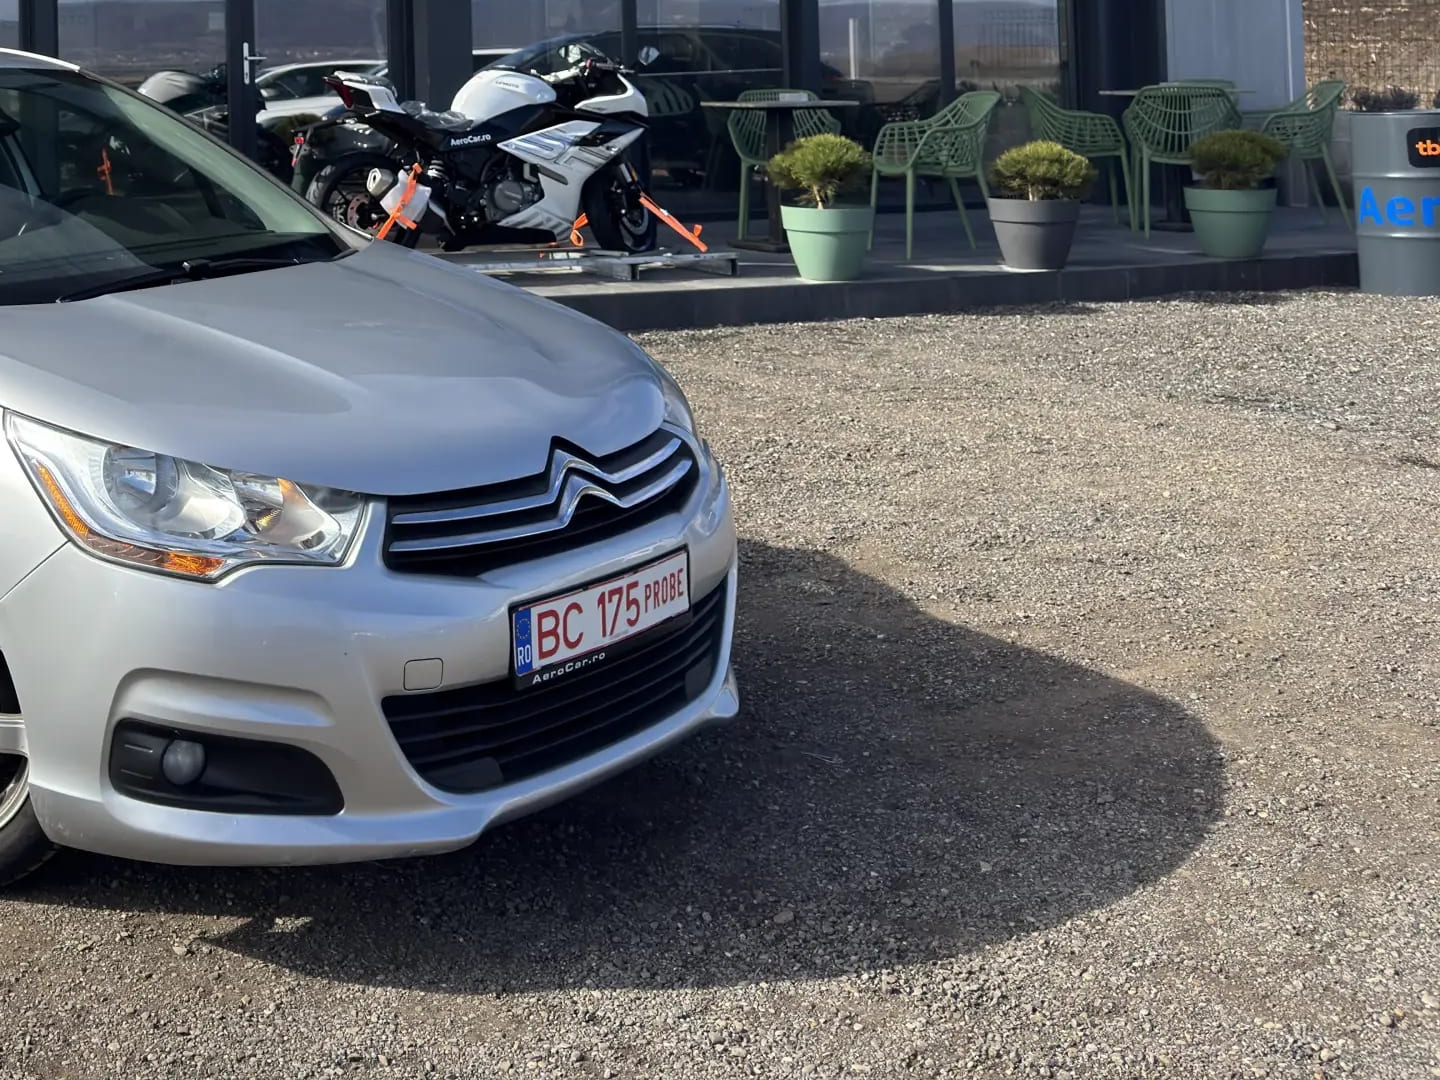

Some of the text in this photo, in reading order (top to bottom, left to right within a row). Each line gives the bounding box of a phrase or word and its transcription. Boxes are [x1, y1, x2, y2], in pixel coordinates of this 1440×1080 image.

[537, 568, 684, 660] BC 175 PROBE
[517, 644, 532, 667] RO
[532, 651, 606, 685] AeroCar.ro
